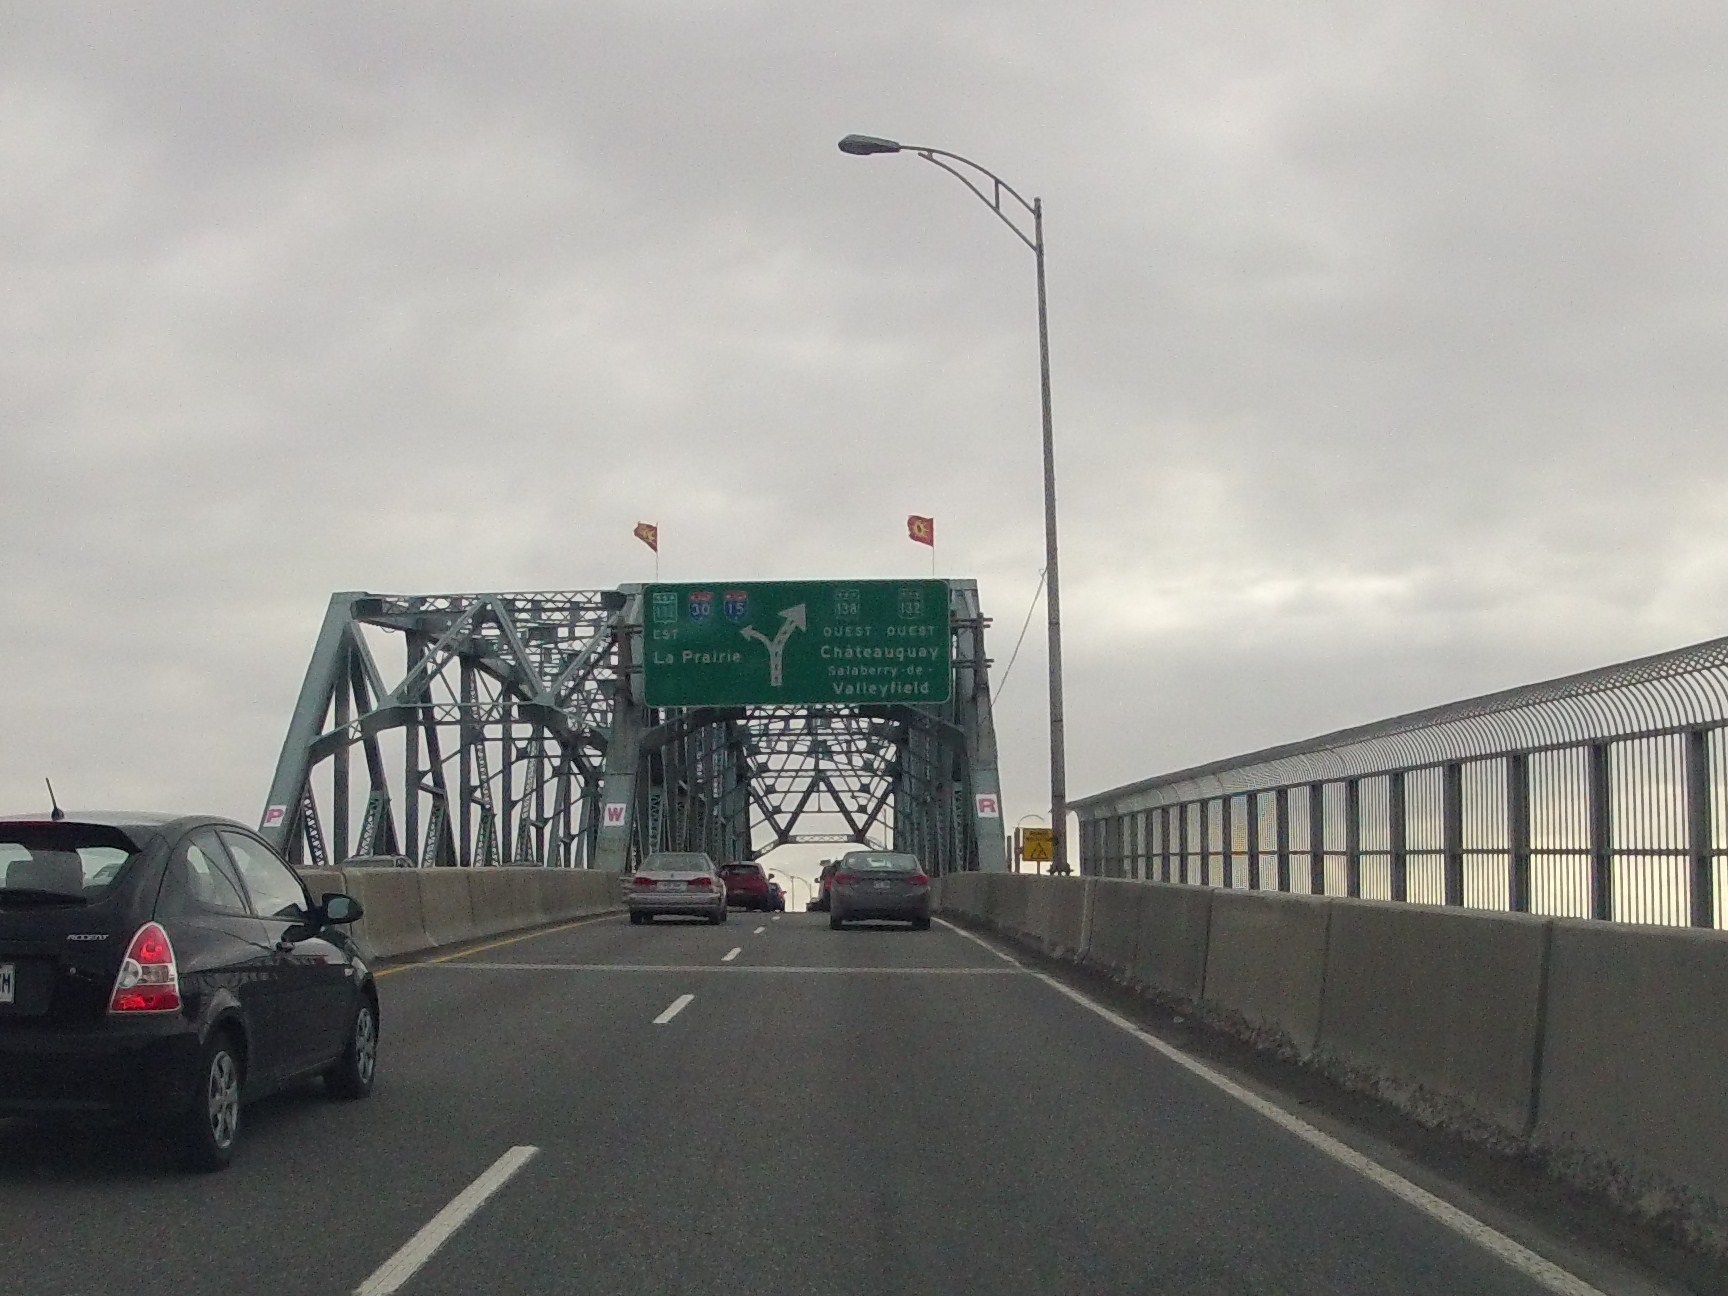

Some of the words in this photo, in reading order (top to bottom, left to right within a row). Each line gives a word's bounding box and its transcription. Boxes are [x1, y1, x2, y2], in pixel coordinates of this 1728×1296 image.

[691, 603, 710, 616] 30
[728, 602, 744, 615] 15
[823, 626, 872, 637] OUEST
[886, 625, 935, 637] OUEST
[653, 651, 674, 664] La
[682, 650, 741, 663] Prairie
[832, 681, 930, 697] Valleyfield
[978, 798, 996, 813] R
[266, 808, 285, 823] P
[607, 807, 624, 822] W
